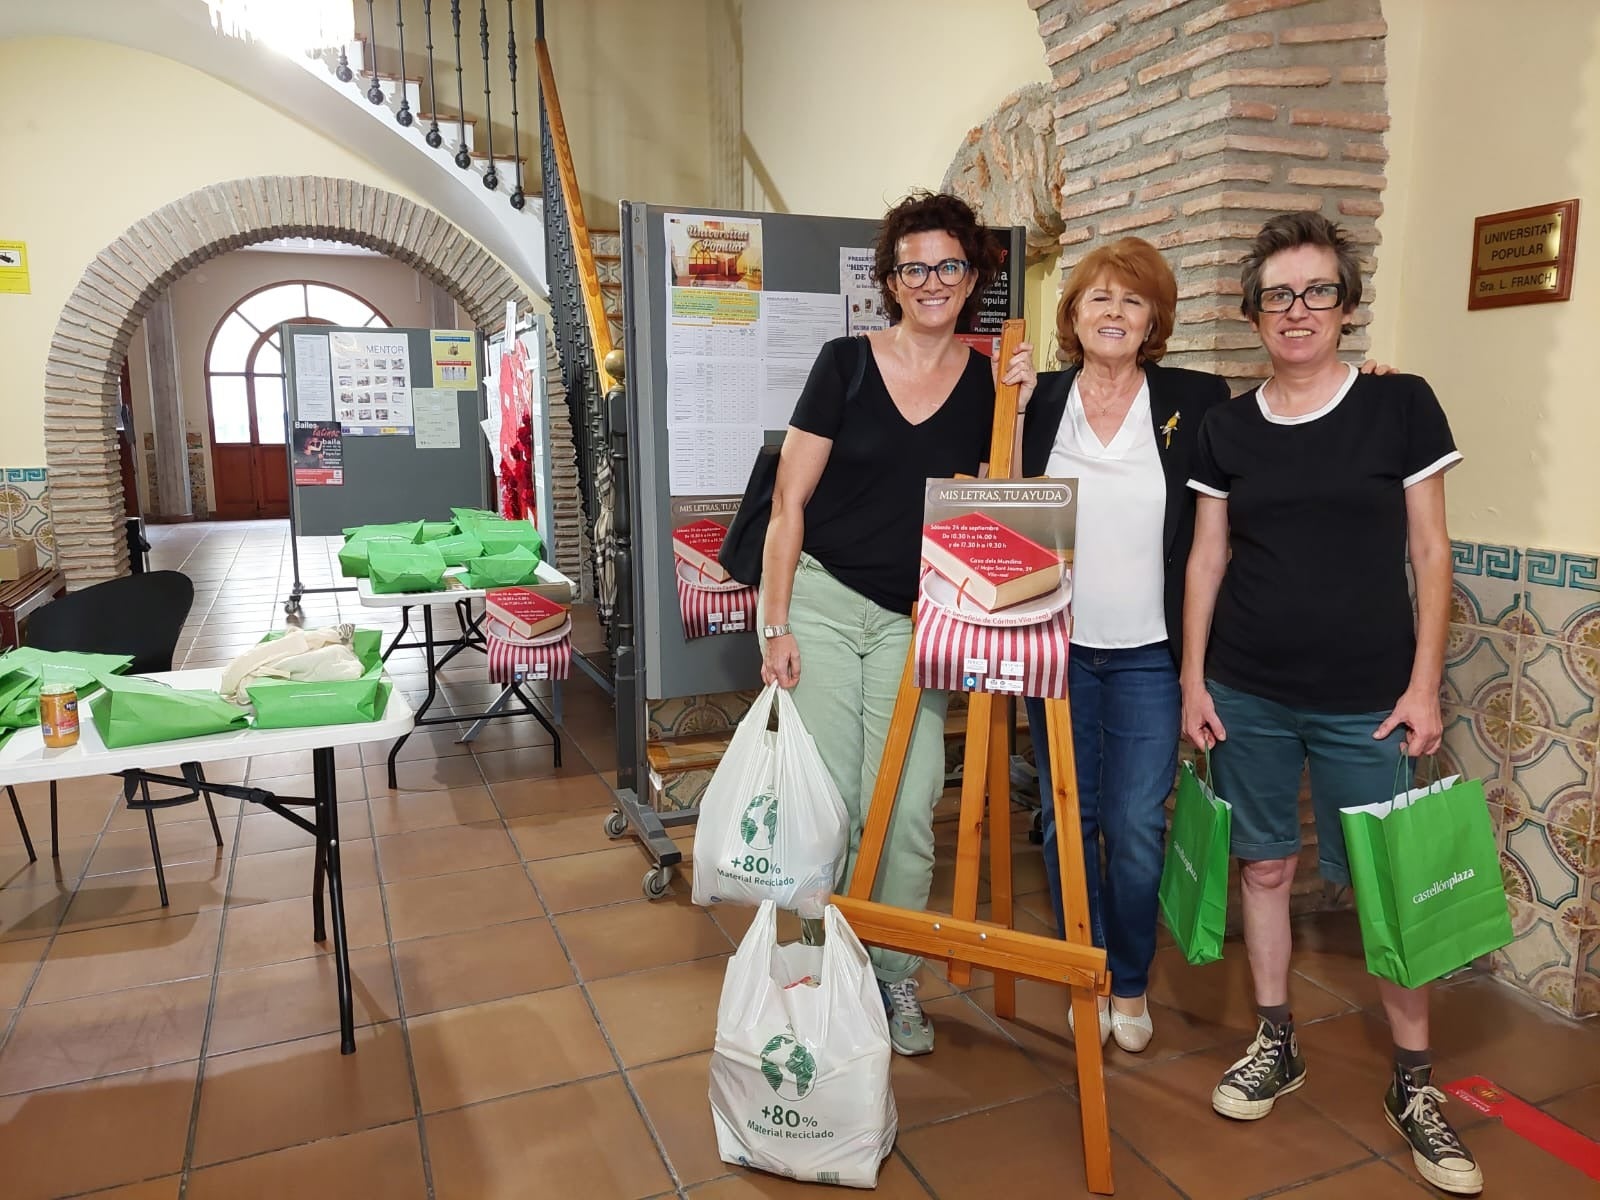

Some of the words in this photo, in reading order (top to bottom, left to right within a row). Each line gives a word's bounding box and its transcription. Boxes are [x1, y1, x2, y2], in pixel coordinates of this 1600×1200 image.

[1484, 222, 1554, 245] UNIVERSITAT
[1492, 243, 1544, 261] POPULAR
[1512, 272, 1552, 288] FRANCH
[982, 296, 1008, 307] opular
[366, 345, 404, 354] MENTOR
[939, 491, 958, 500] MIS
[961, 490, 1001, 502] LETRAS,
[1004, 491, 1020, 500] TU
[1021, 491, 1062, 500] AYUDA
[717, 868, 752, 884] Material
[754, 877, 794, 888] Reciclado
[761, 1105, 818, 1128] +80%
[747, 1120, 783, 1138] Material
[786, 1130, 834, 1139] Reciclado
